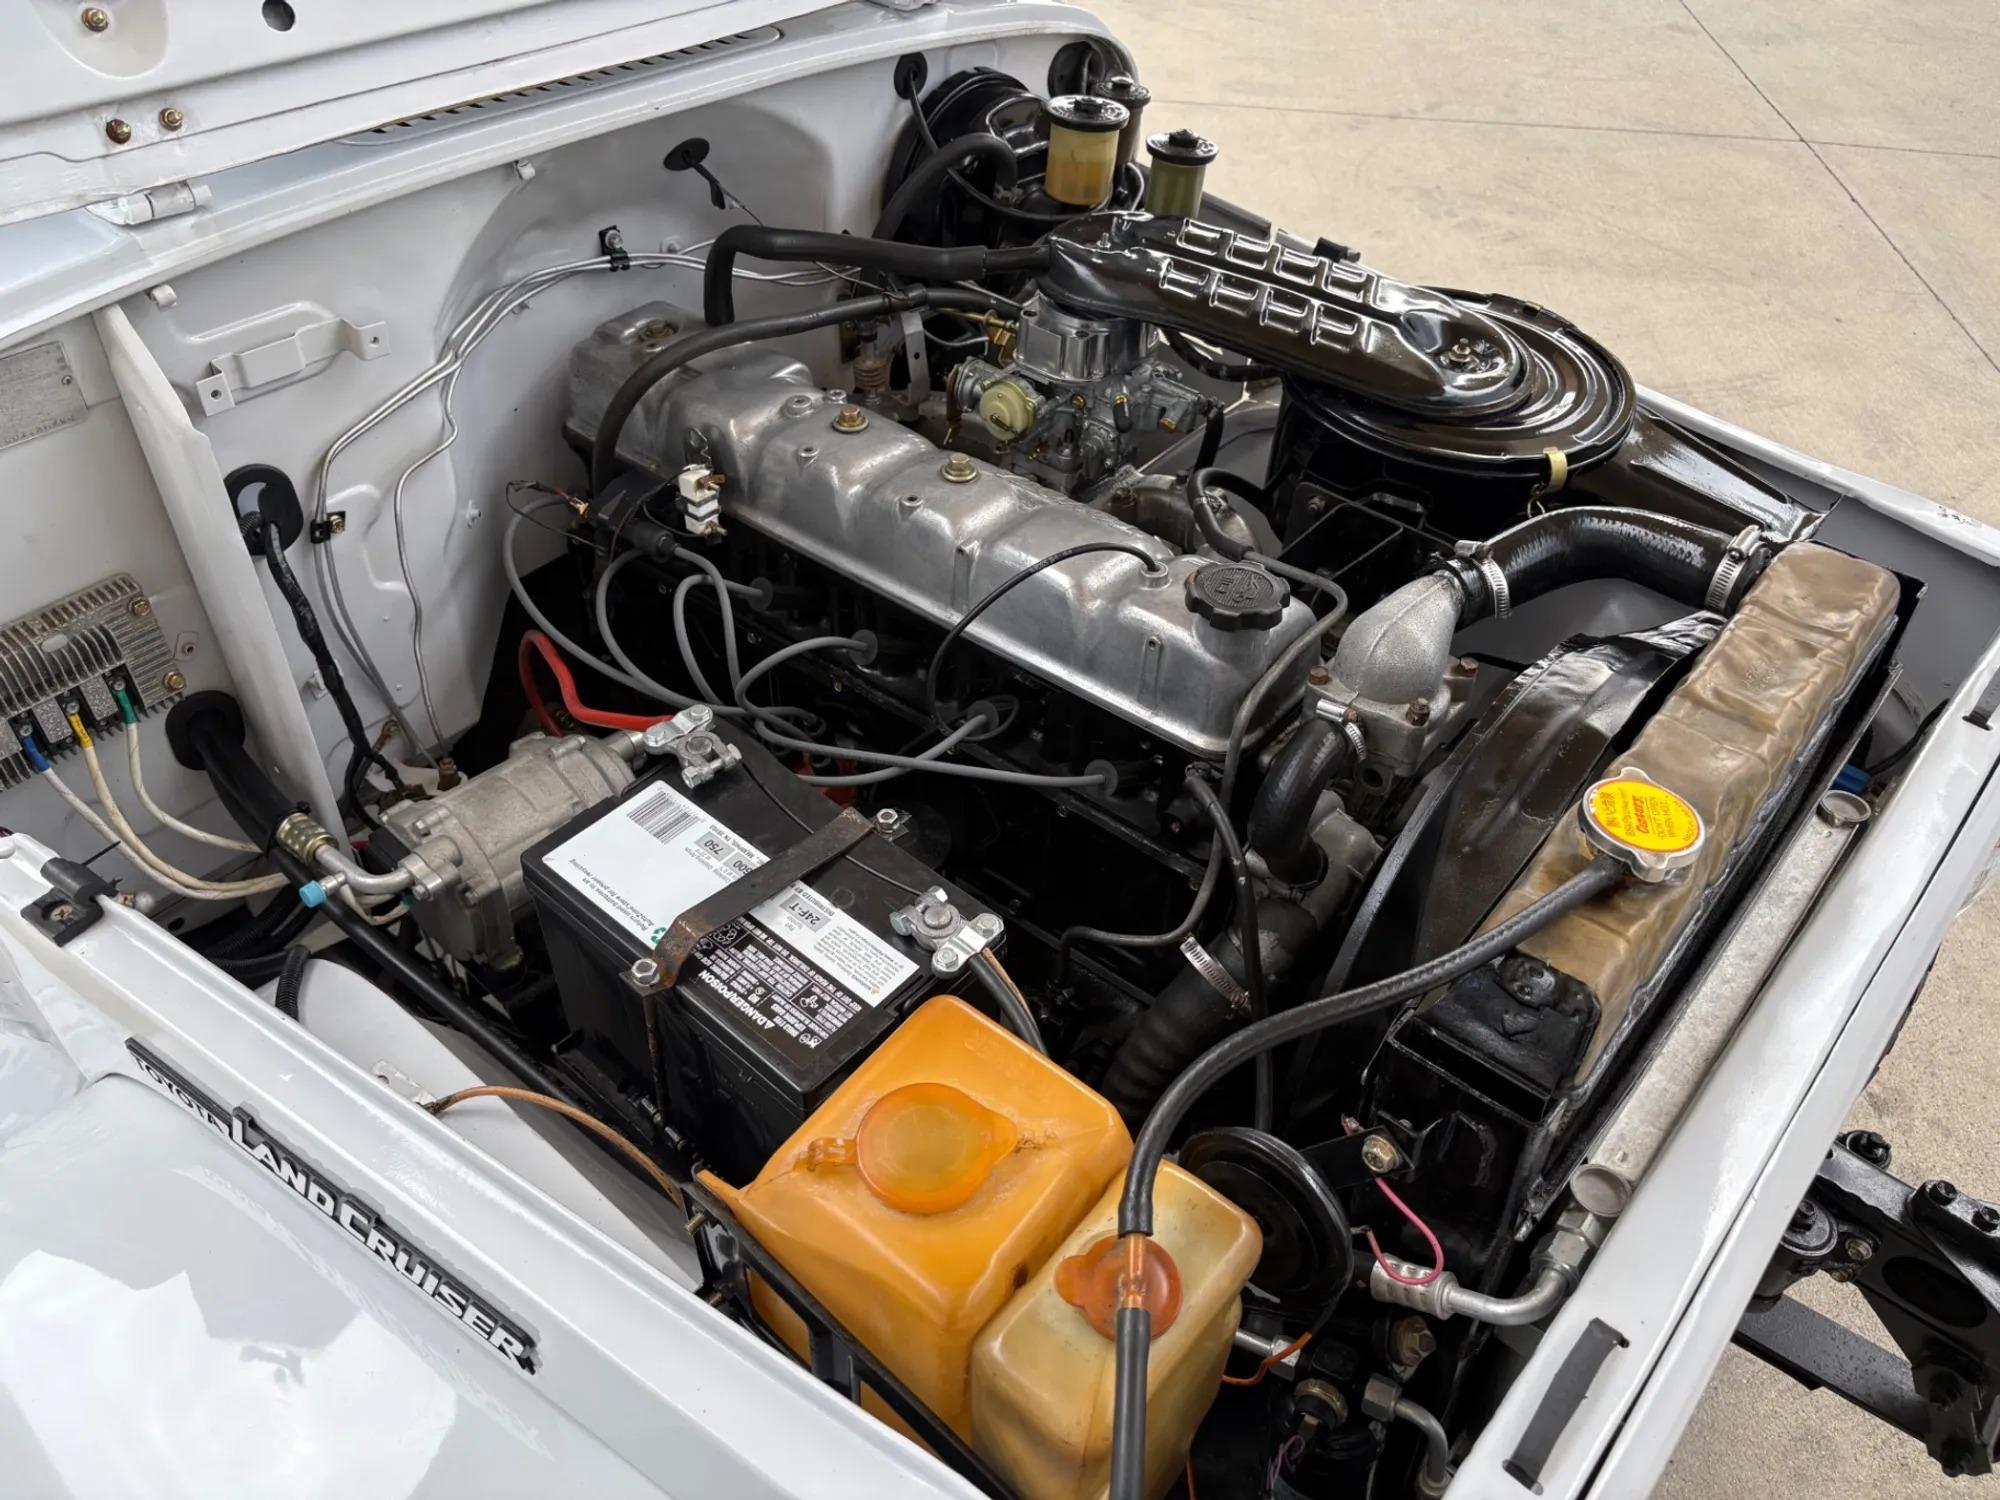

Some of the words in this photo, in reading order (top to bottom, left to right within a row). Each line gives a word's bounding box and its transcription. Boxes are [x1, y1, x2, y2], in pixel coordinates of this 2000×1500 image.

[702, 838, 725, 855] 750
[788, 900, 821, 925] 24F-T
[696, 968, 769, 1025] DANGER/POISON
[135, 1057, 231, 1141] TOYOTA
[231, 1111, 336, 1221] LAND
[338, 1198, 533, 1372] CRUISER
